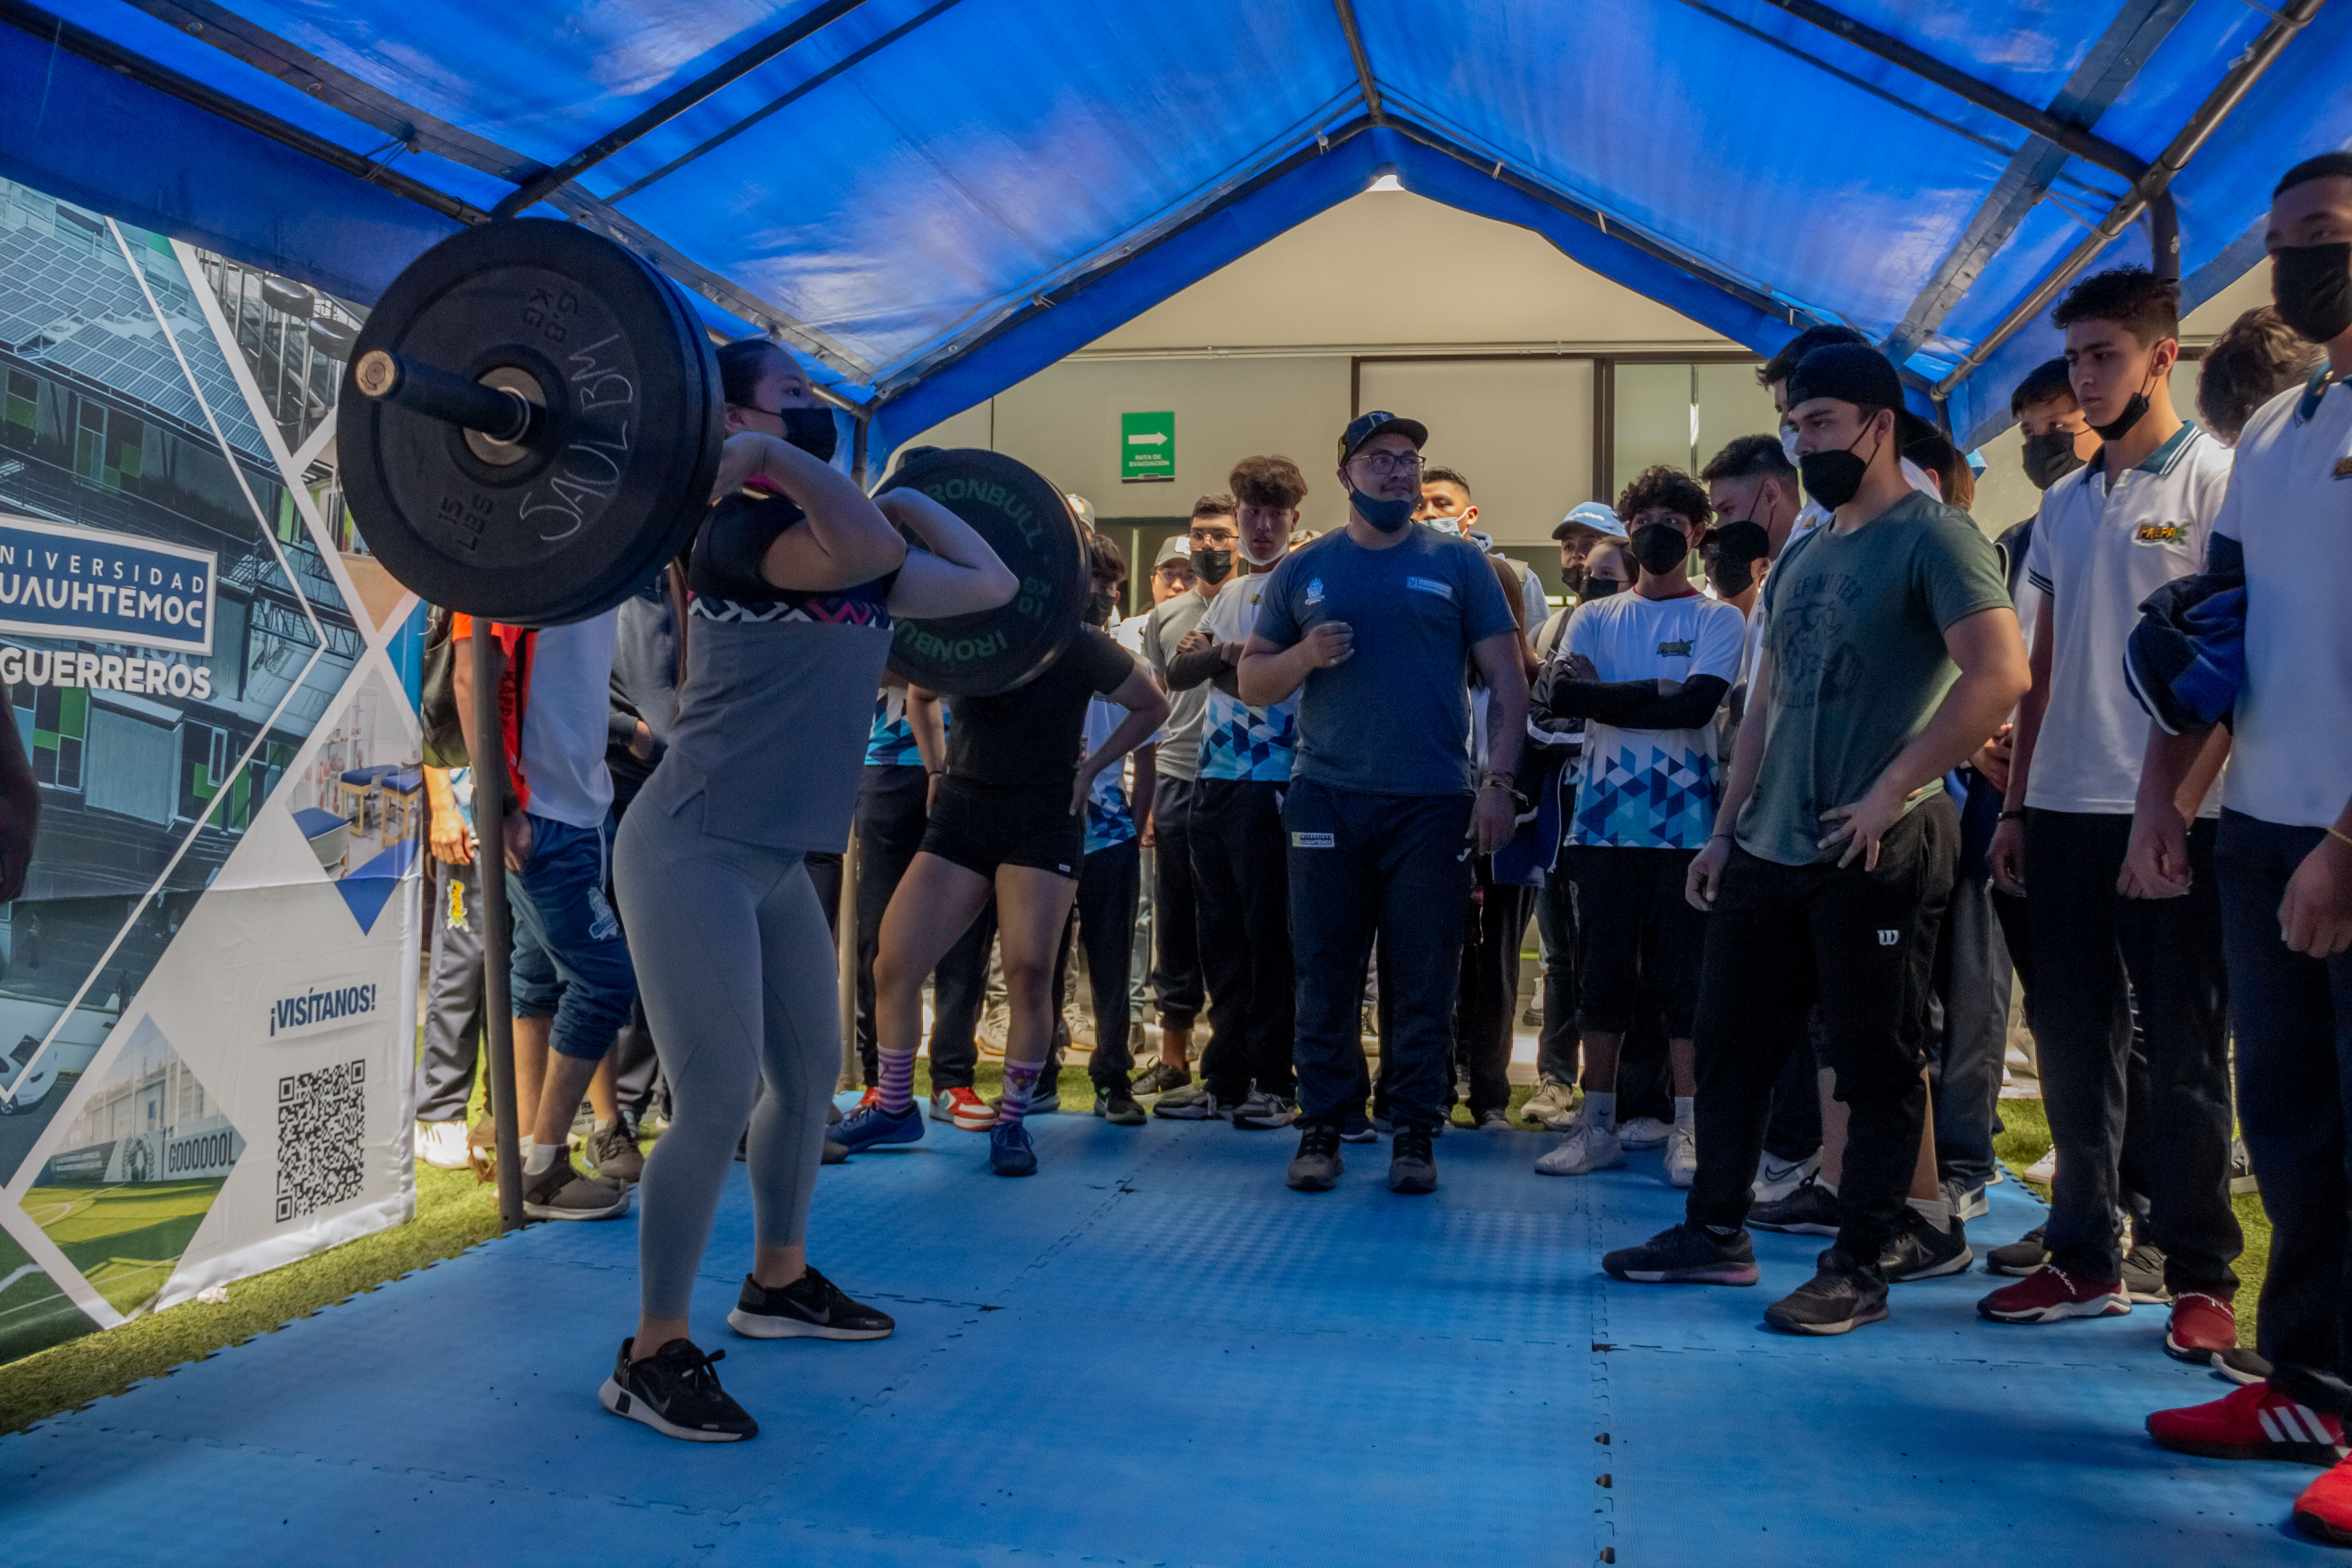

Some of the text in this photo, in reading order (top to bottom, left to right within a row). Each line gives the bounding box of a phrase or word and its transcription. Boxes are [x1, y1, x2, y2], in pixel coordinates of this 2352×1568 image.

[519, 419, 628, 541] SAUL
[923, 478, 1043, 549] RONBULL
[893, 619, 1009, 661] IRONBU
[0, 647, 211, 700] GUERREROS
[270, 984, 376, 1037] ¡VISÍTANOS!
